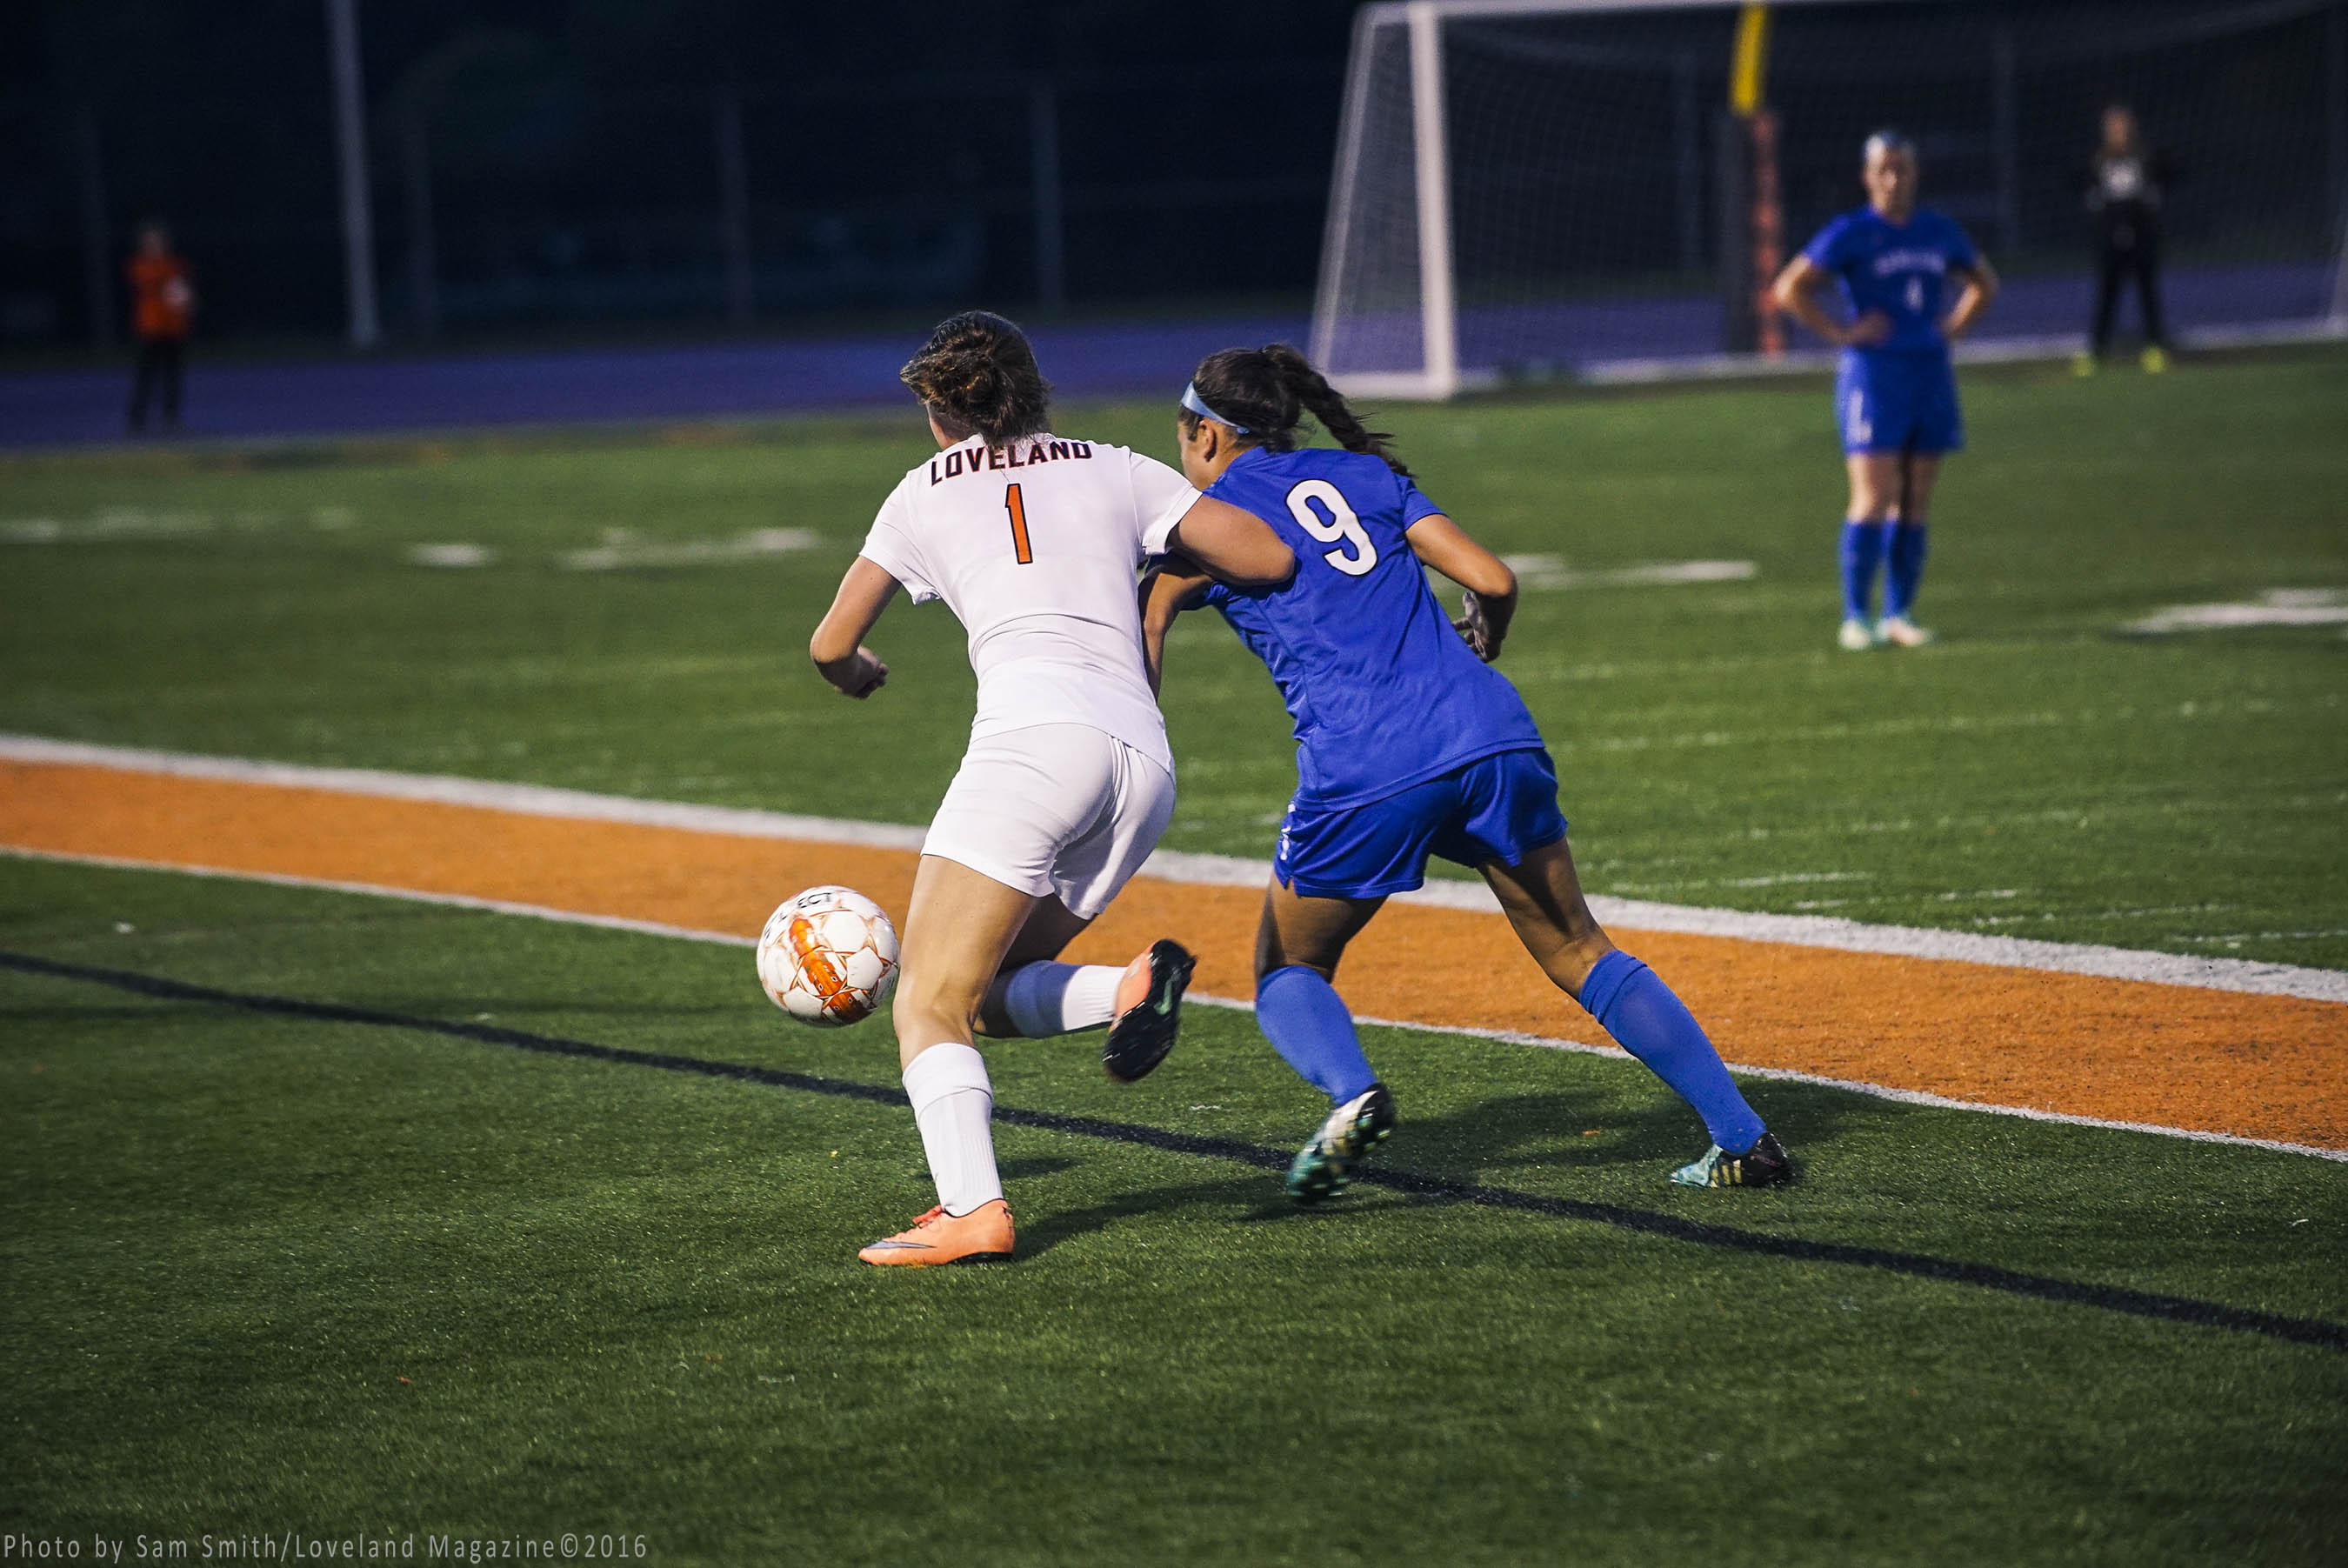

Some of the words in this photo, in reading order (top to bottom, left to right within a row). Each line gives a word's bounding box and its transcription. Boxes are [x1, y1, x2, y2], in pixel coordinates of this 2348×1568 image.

[931, 441, 1093, 487] LOVELAND
[1004, 483, 1033, 564] 1
[1284, 478, 1378, 577] 9
